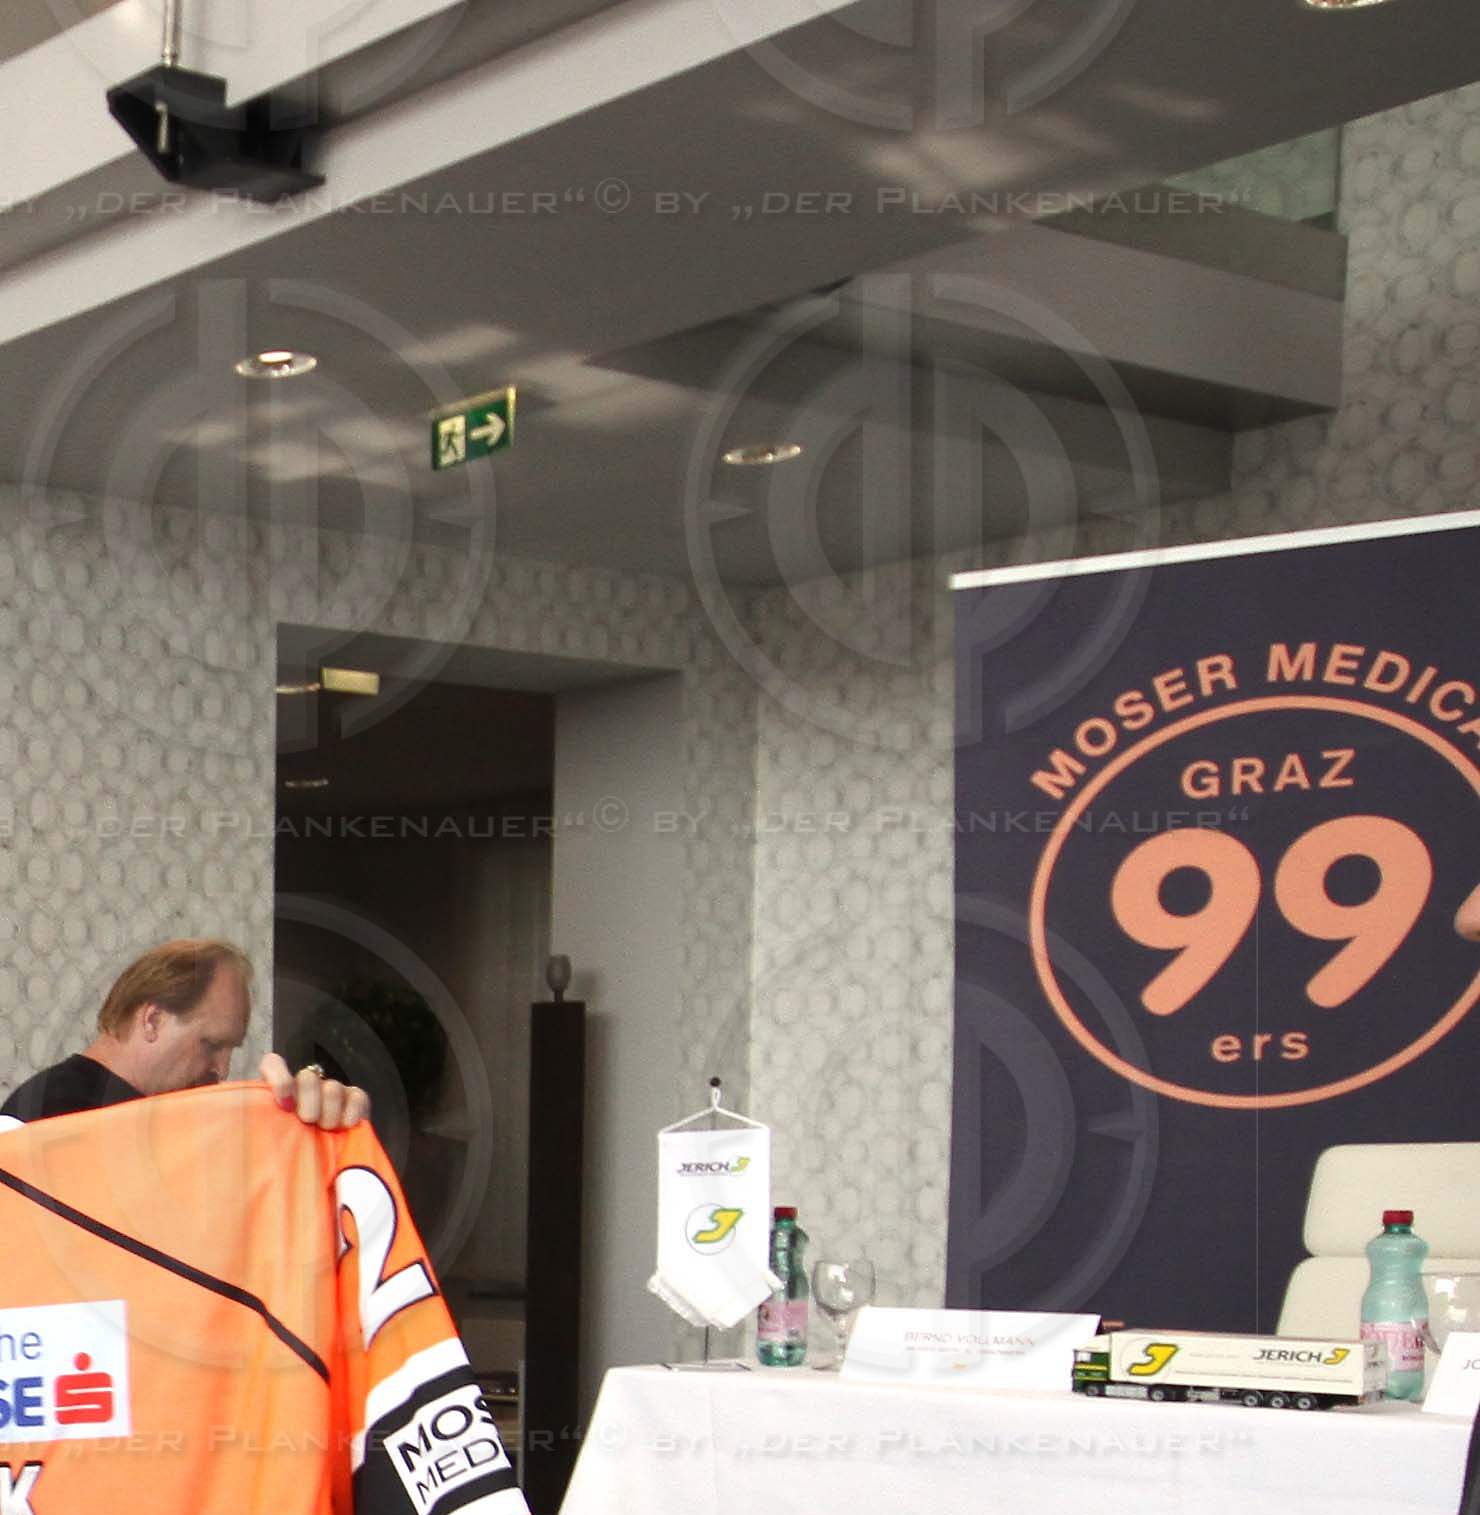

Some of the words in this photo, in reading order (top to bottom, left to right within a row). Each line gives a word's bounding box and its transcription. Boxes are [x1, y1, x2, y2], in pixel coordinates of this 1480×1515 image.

[1029, 652, 1237, 801] MOSER
[1180, 748, 1357, 799] GRAZ
[1110, 814, 1434, 1017] 99
[1210, 1030, 1311, 1063] ers
[1251, 1348, 1323, 1363] JERICH
